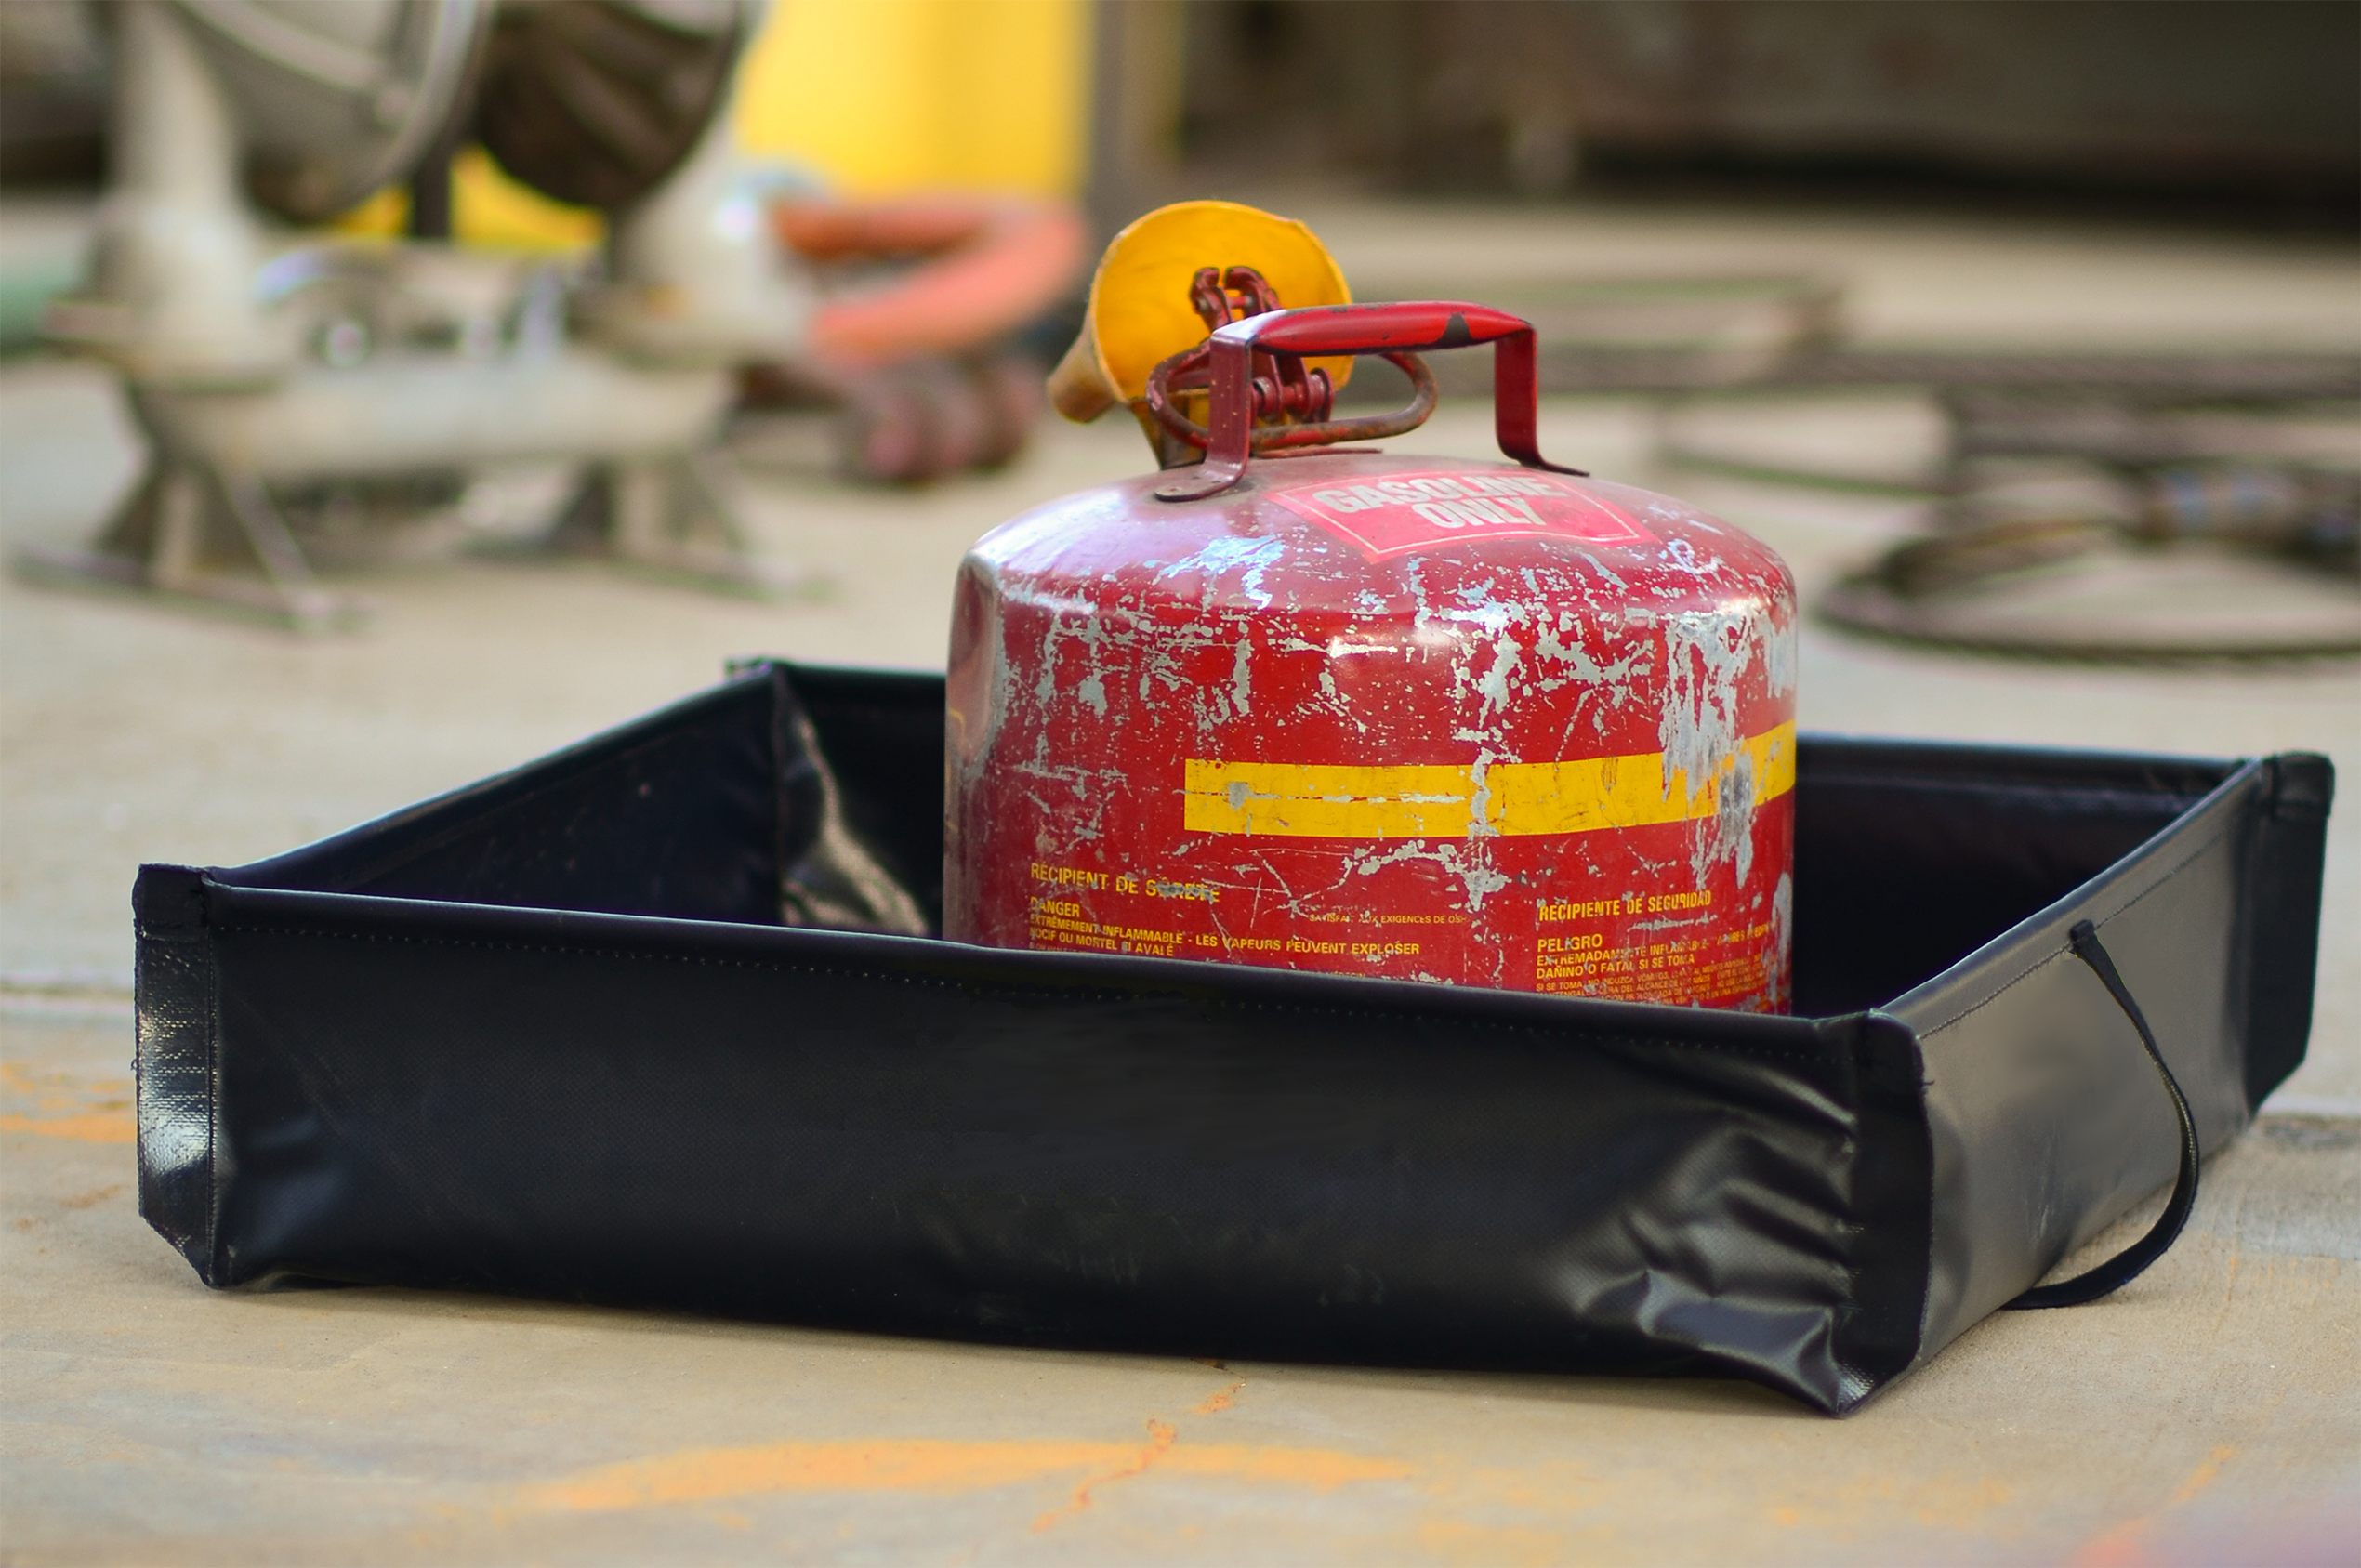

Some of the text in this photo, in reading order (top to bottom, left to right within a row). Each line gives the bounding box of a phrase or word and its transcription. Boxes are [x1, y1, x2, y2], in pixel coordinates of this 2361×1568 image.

[1312, 475, 1567, 513] GASOLINE
[1411, 496, 1547, 529] ONLY
[1030, 861, 1109, 890] RÉCIPIENT
[1115, 876, 1139, 894] DE
[1030, 896, 1080, 917] DANGER
[1380, 915, 1431, 924] EXIGENCES
[1433, 915, 1445, 924] DE
[1539, 890, 1711, 921] RECIPIENTE DE SEGURIDAD
[1059, 931, 1074, 943] OU
[1075, 935, 1118, 951] MORTEL
[1102, 925, 1183, 944] INFLAMMABLE
[1195, 934, 1218, 947] LES
[1286, 939, 1347, 955] PEUVENT
[1352, 942, 1420, 955] EXPLOSER
[1536, 965, 1584, 980] DAÑINO
[1588, 963, 1597, 975] O
[1639, 958, 1649, 970] SI
[1651, 956, 1664, 968] SE
